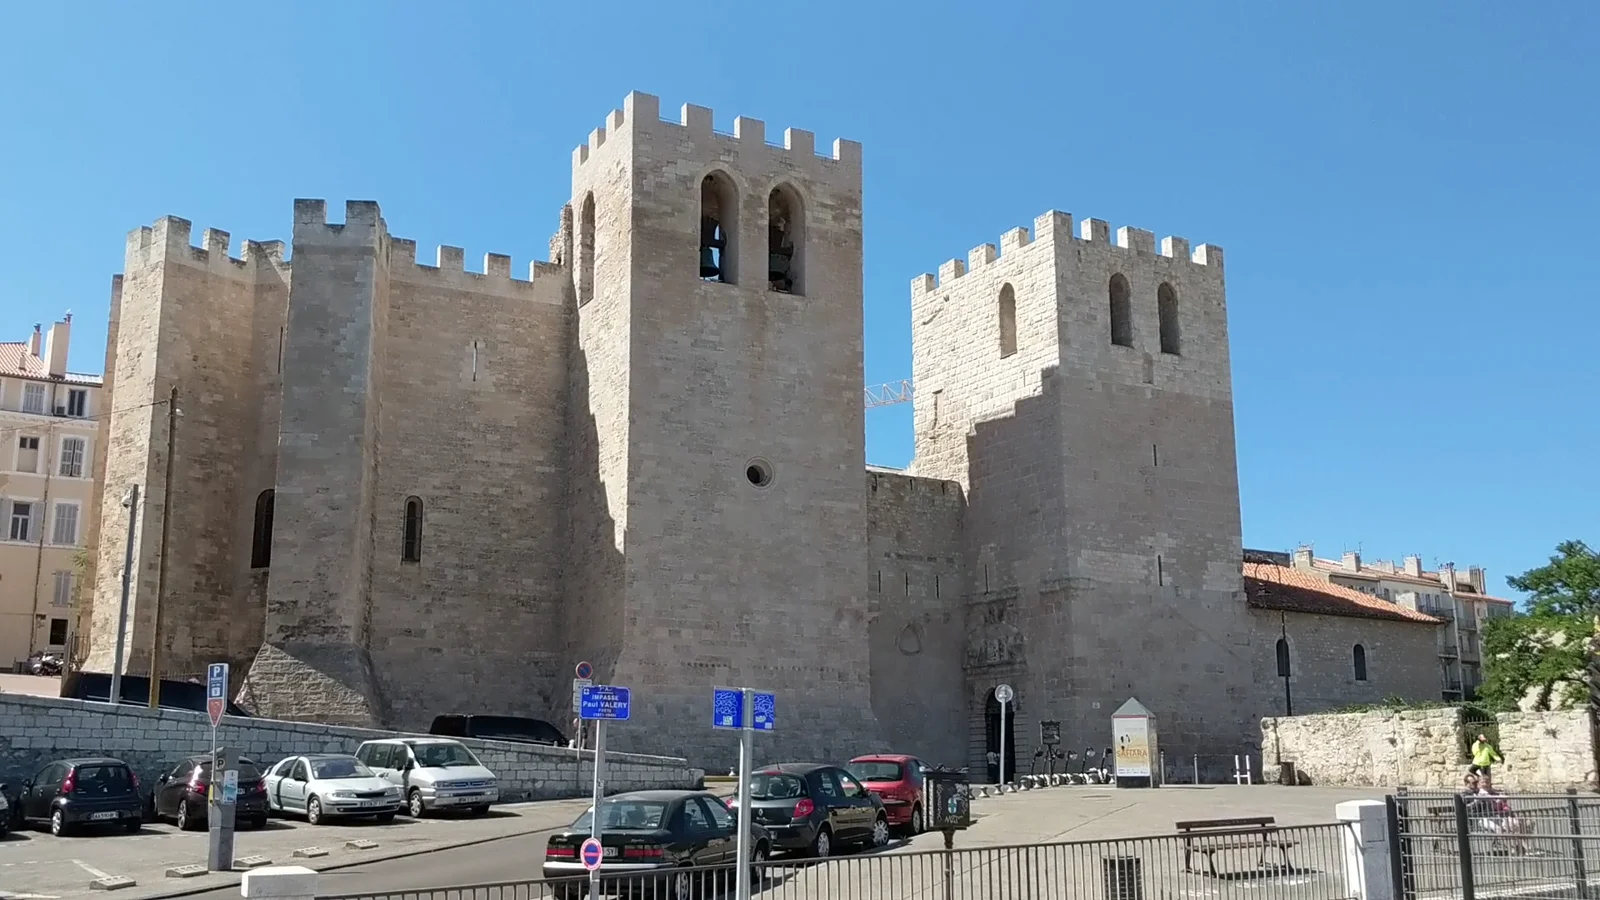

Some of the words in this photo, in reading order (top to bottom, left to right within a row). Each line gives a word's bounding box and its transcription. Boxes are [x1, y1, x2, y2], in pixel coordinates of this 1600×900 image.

[213, 666, 221, 678] P
[582, 700, 599, 708] Paul
[599, 701, 628, 709] VALERY
[1116, 749, 1148, 758] SAHARA
[217, 759, 224, 769] P
